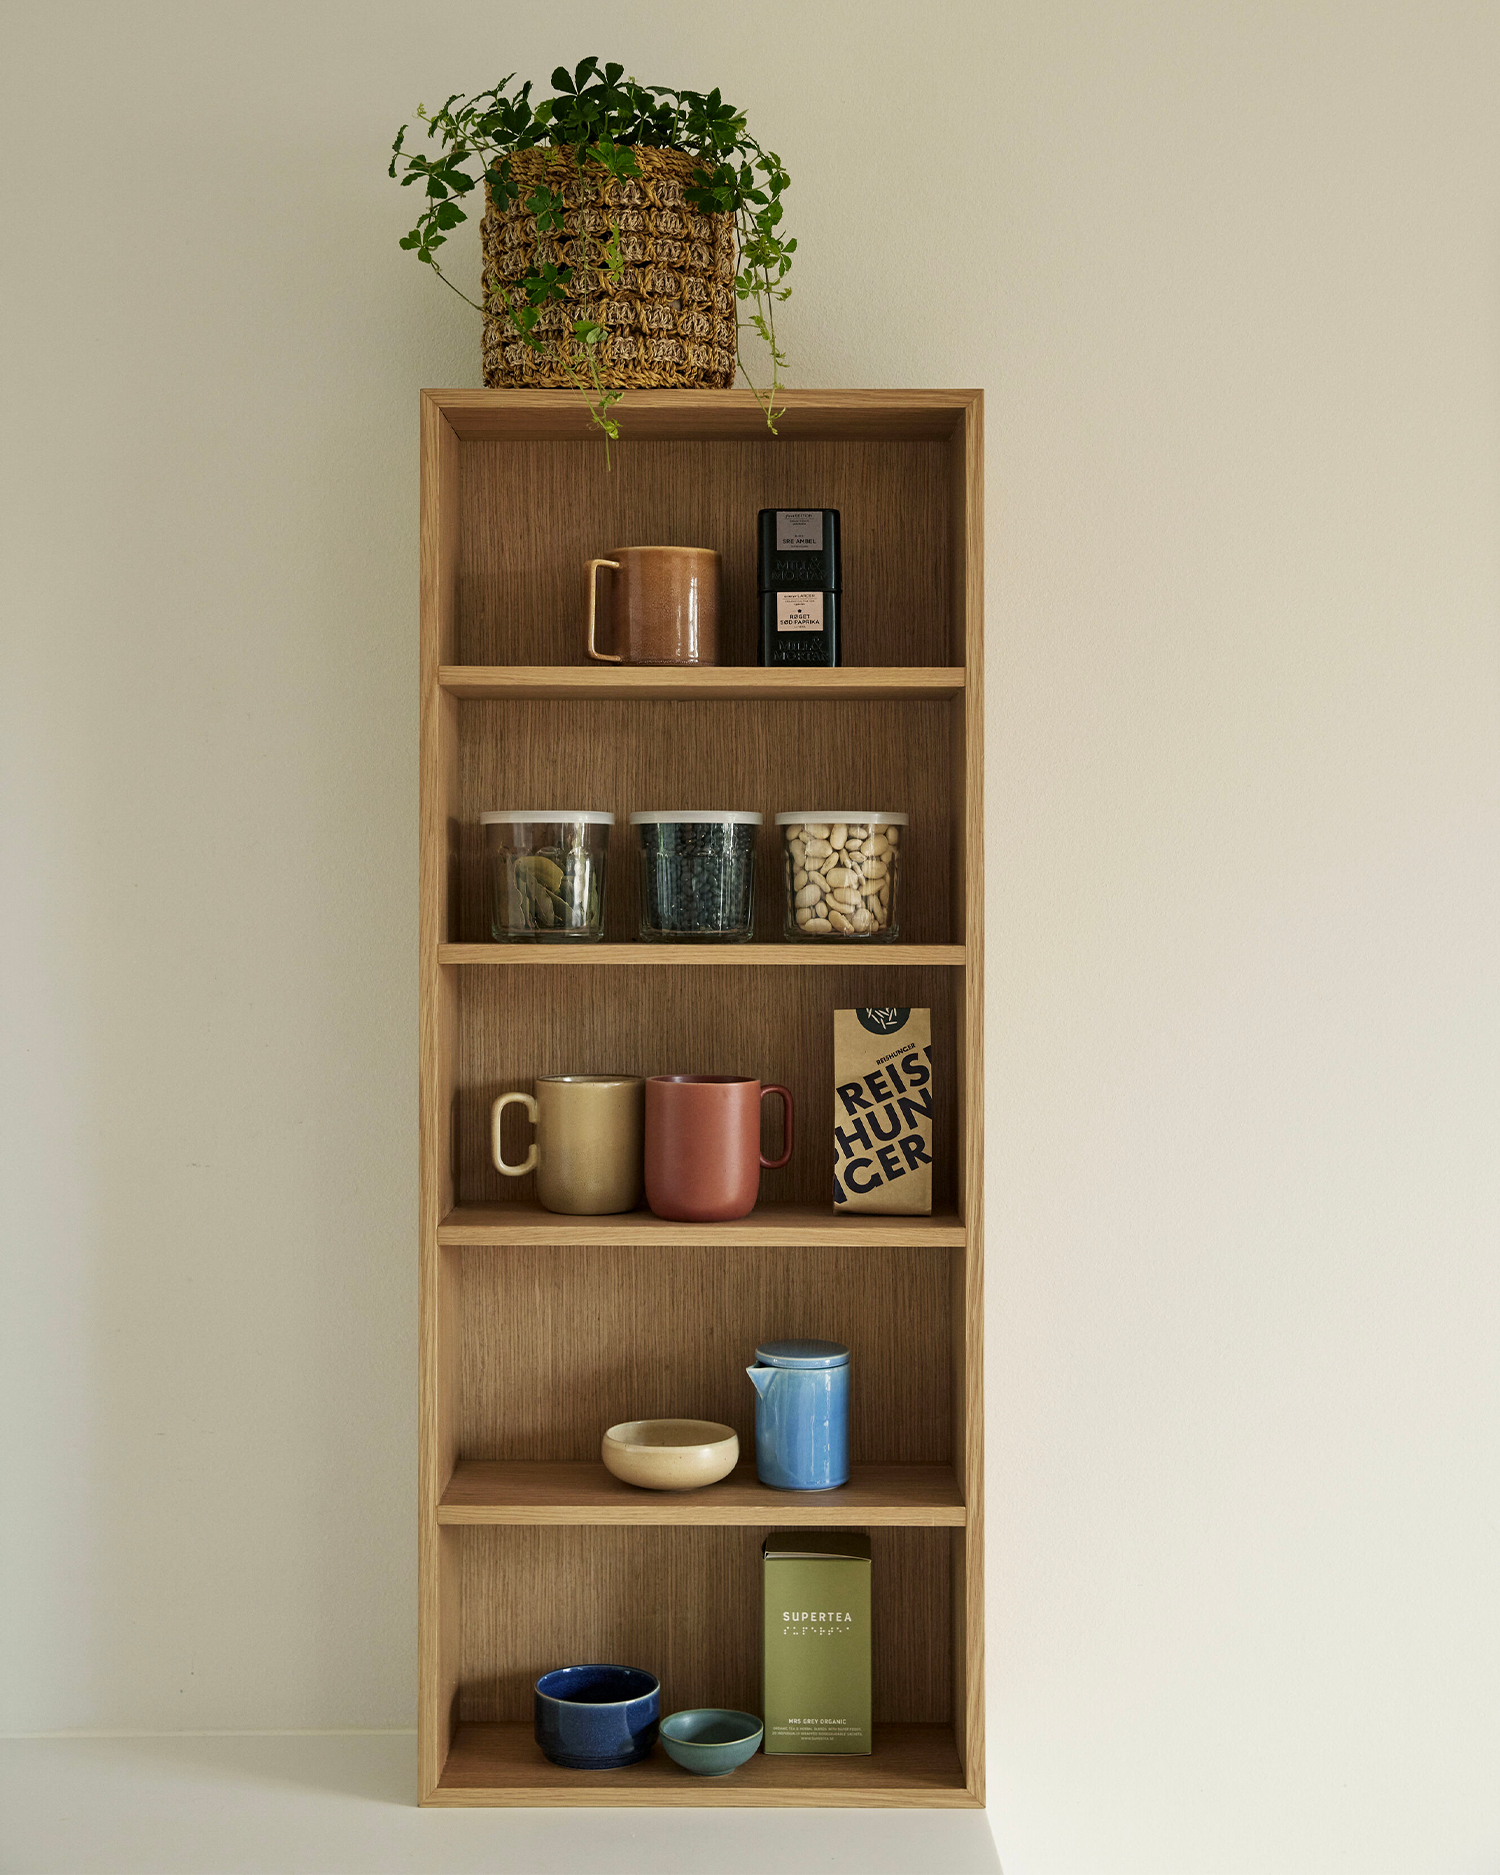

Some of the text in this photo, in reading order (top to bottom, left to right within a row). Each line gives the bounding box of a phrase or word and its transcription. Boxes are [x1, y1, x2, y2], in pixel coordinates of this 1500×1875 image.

[875, 1042, 916, 1066] REISHUNGER
[836, 1045, 932, 1116] REIS
[834, 1087, 932, 1165] HUN
[783, 1611, 852, 1622] SUPERTEA
